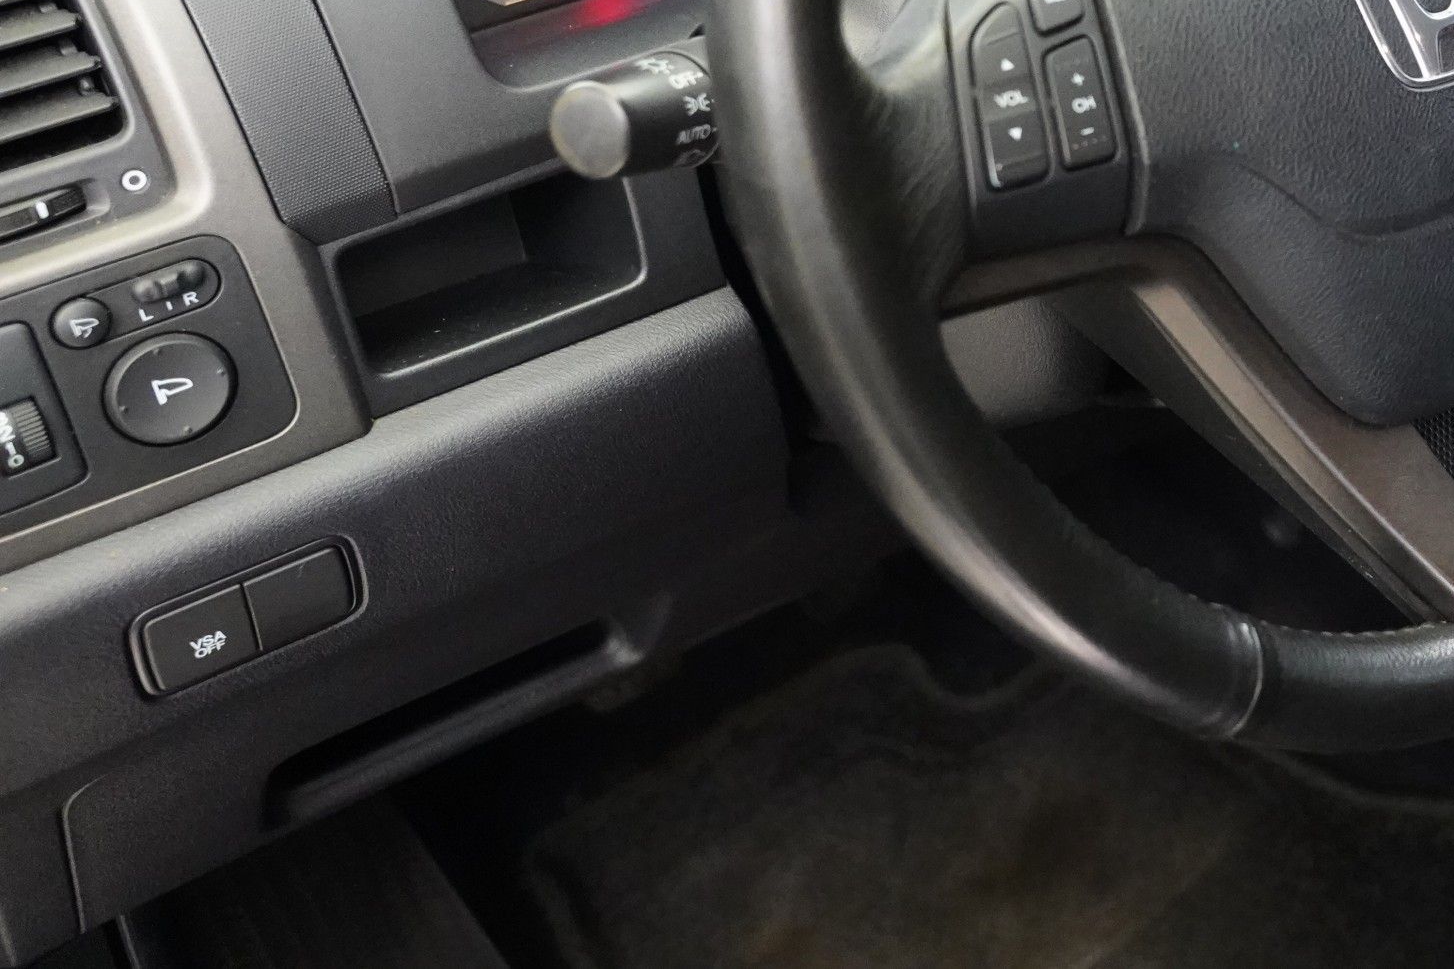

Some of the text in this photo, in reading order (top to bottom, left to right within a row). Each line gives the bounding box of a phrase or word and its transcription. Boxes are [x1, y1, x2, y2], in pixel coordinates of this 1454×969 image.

[676, 123, 712, 145] AUTO
[138, 291, 200, 322] L R
[189, 630, 227, 651] VSA
[194, 641, 226, 658] OFF
